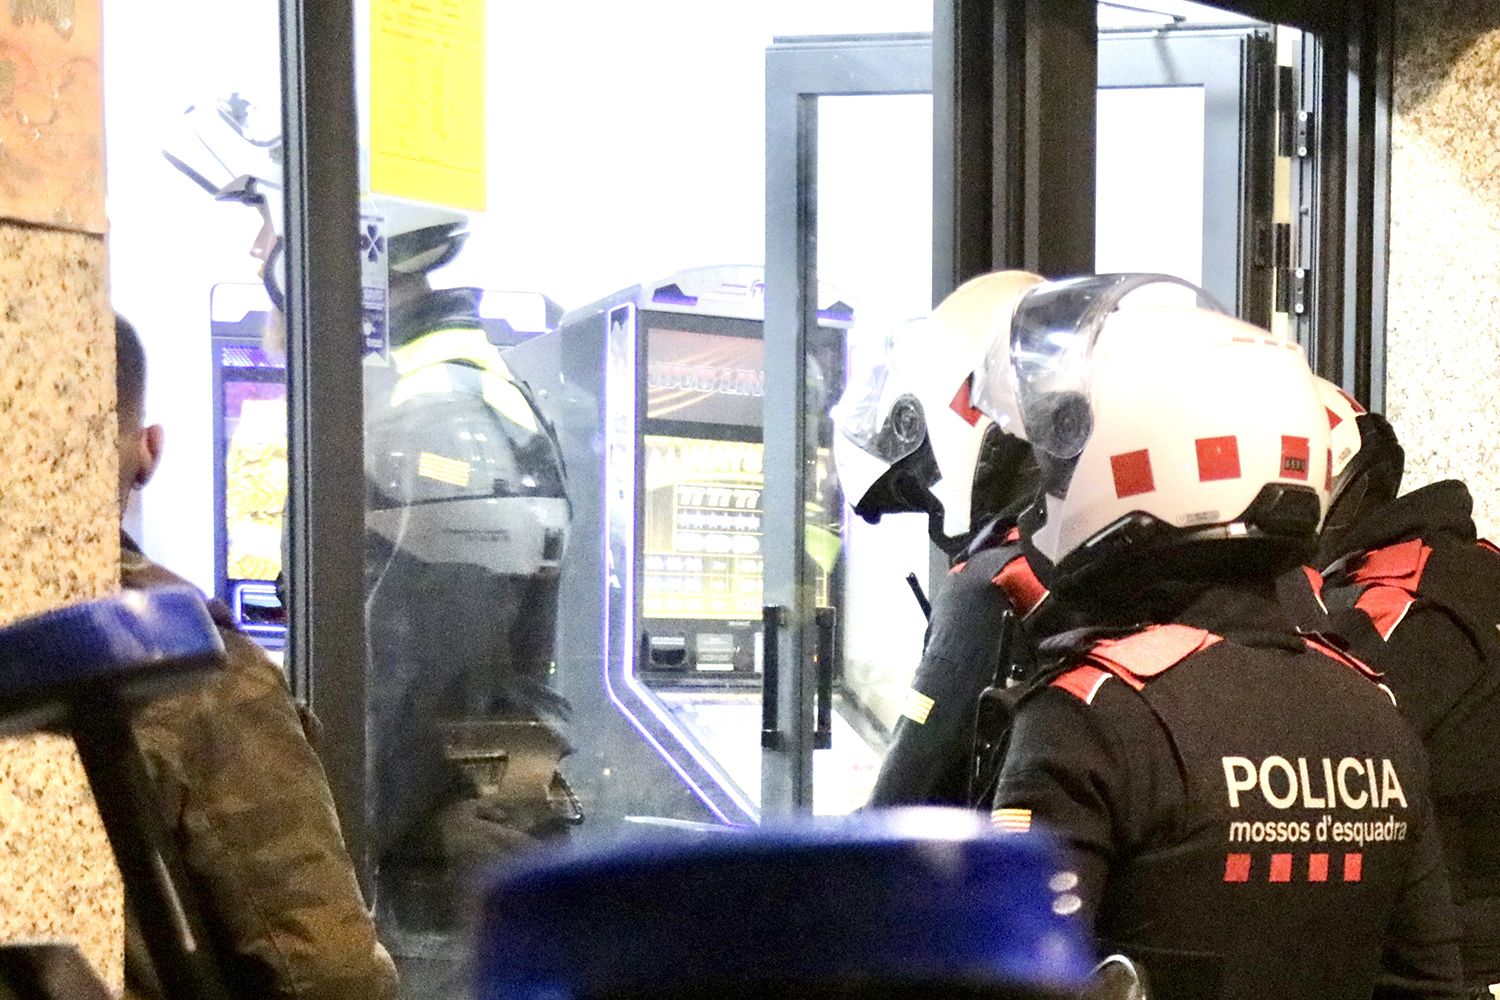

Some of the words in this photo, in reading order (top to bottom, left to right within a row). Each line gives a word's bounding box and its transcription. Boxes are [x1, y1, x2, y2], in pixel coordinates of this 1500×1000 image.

[1222, 755, 1408, 810] POLICIA
[1229, 819, 1311, 843] mossos
[1316, 815, 1408, 847] d'esquadra
